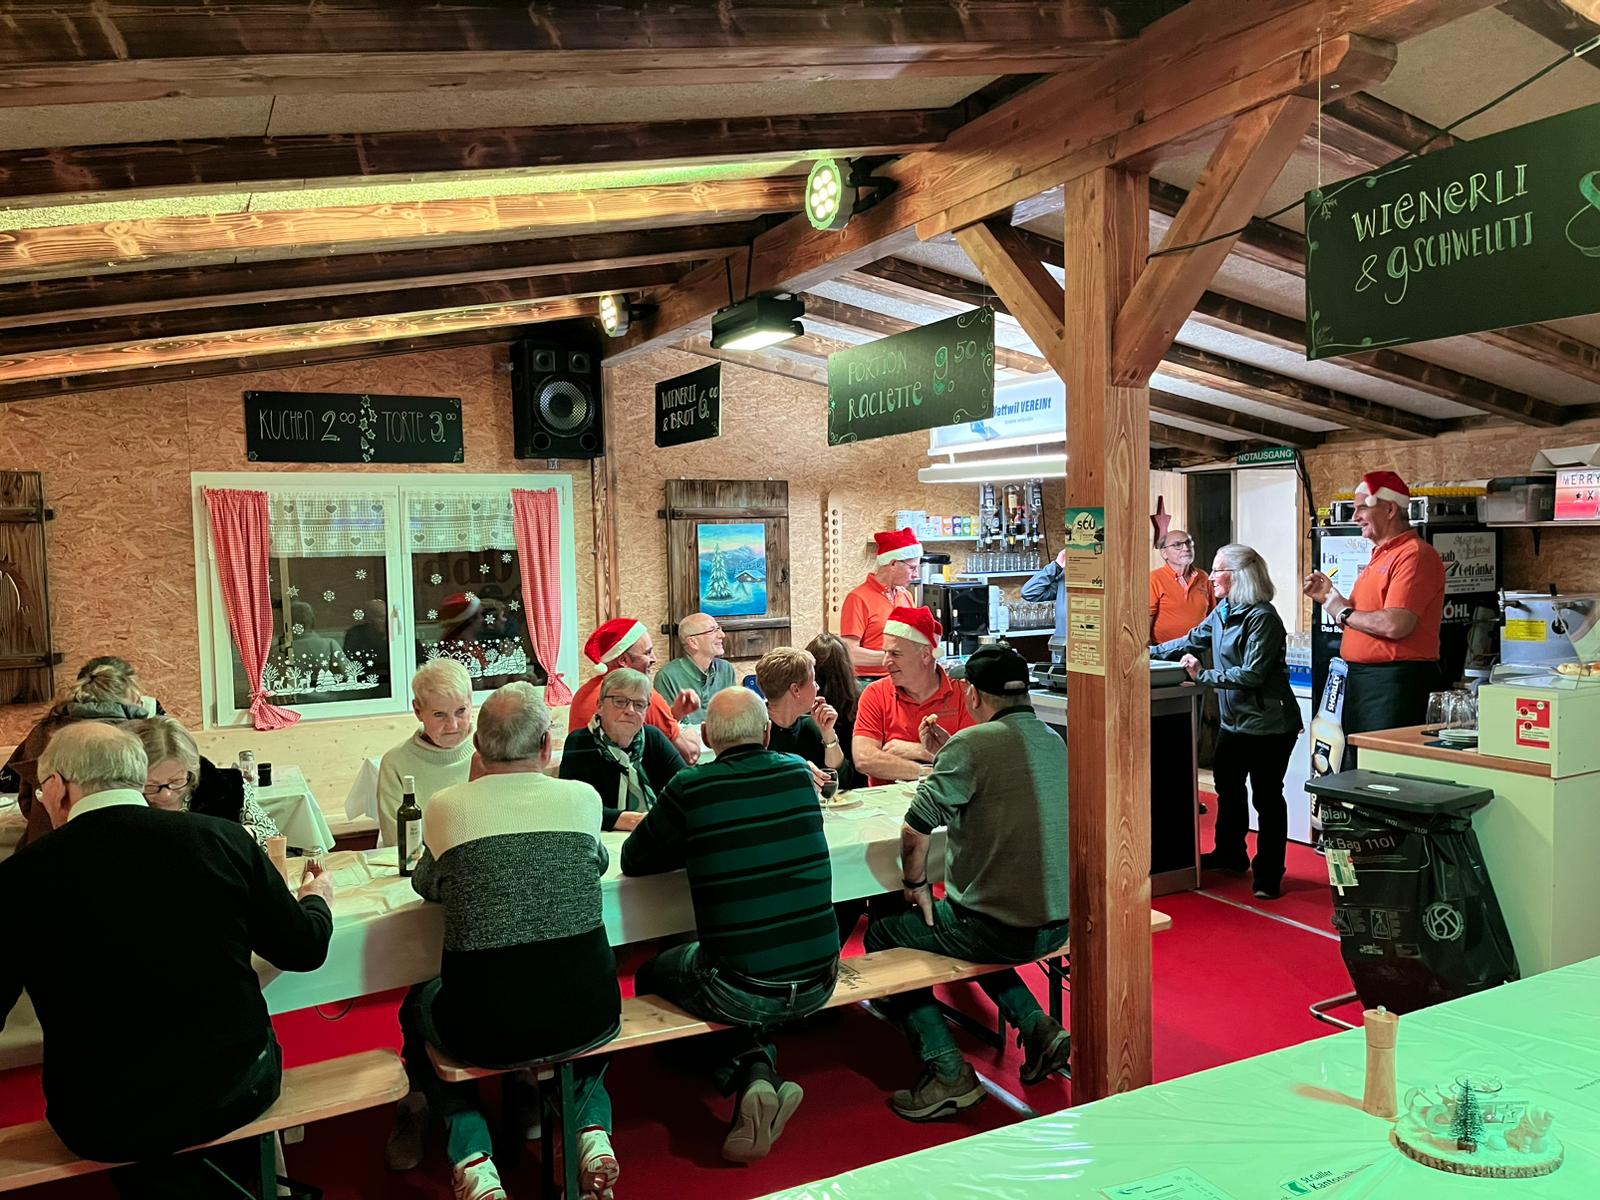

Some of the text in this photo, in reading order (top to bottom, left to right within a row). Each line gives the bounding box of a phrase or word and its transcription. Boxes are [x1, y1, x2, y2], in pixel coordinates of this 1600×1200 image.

[1354, 254, 1378, 292] &
[669, 406, 697, 430] BROT
[1238, 449, 1292, 462] NOTAUSGANG
[1336, 837, 1362, 853] Bag
